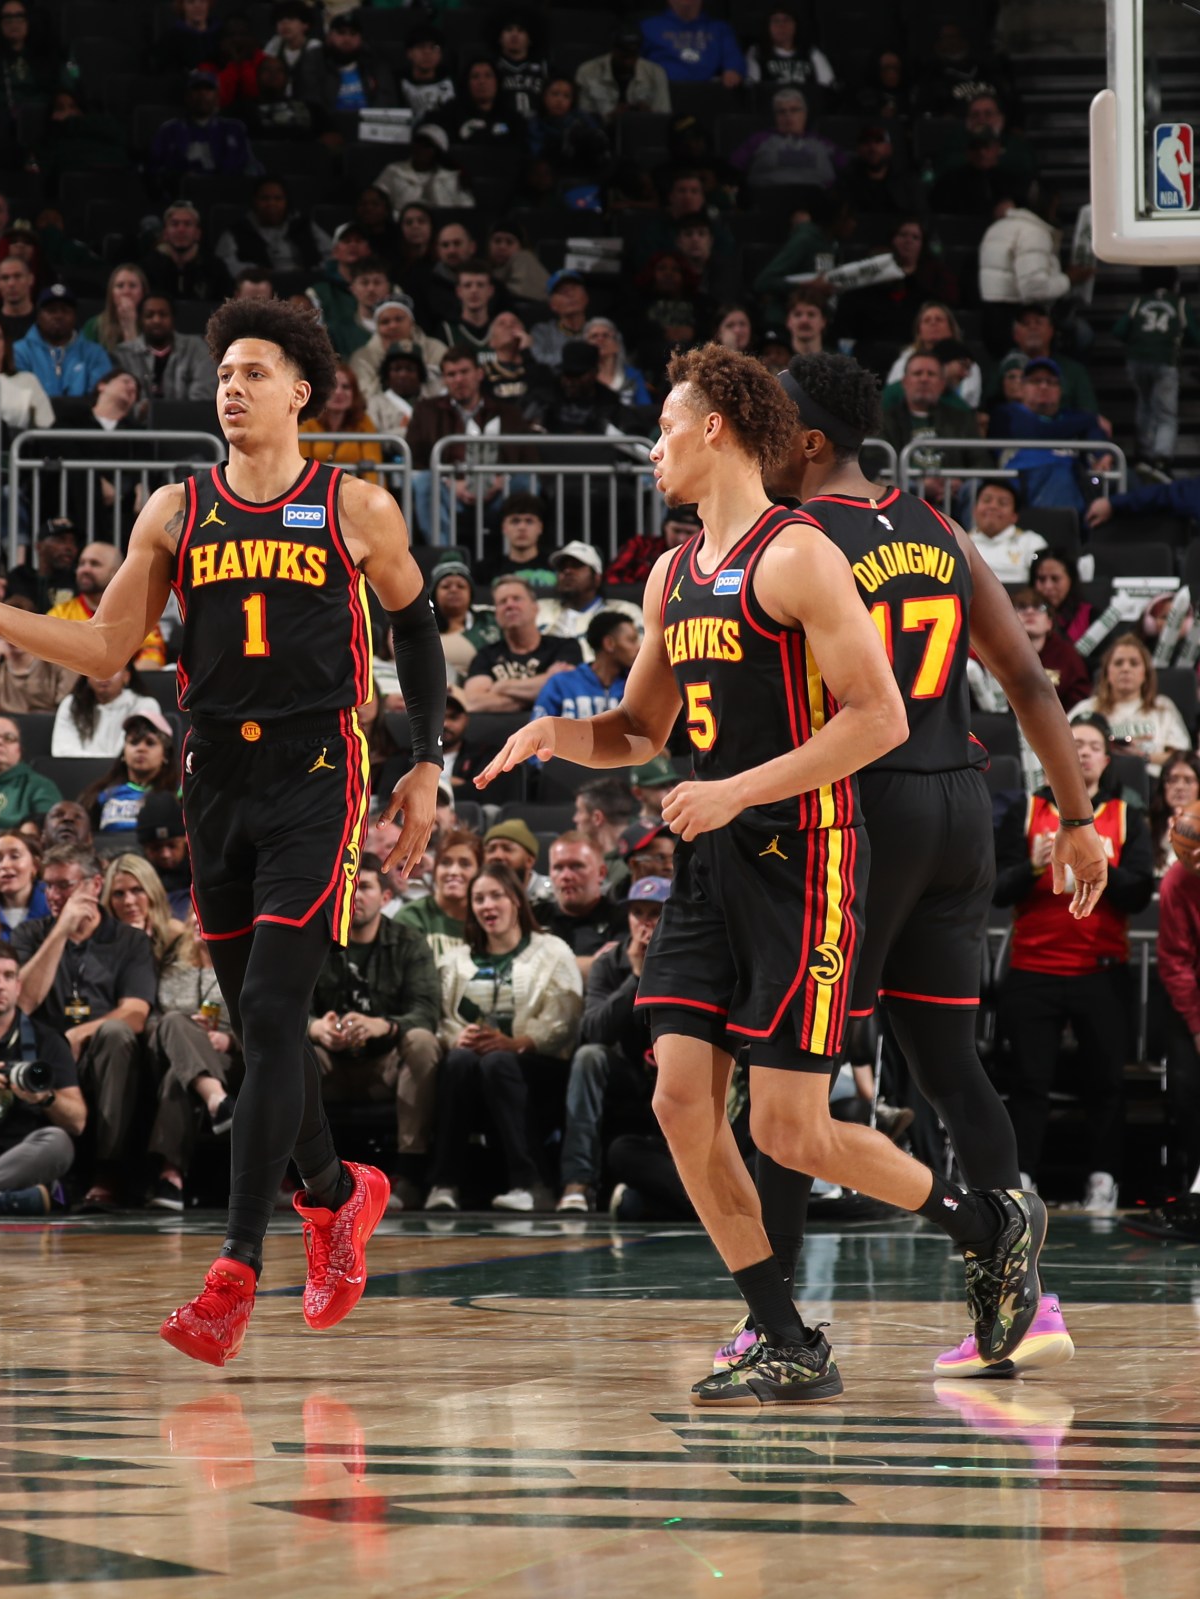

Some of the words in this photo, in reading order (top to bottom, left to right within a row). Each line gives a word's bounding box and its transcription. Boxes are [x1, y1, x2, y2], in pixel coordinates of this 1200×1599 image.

[1159, 190, 1179, 206] NBA
[287, 510, 321, 522] paze
[189, 539, 328, 589] HAWKS
[716, 575, 741, 588] paze
[852, 541, 956, 593] OKONGWU
[242, 592, 271, 657] 1
[664, 615, 745, 668] HAWKS
[244, 727, 260, 736] ATL
[684, 681, 717, 752] 5
